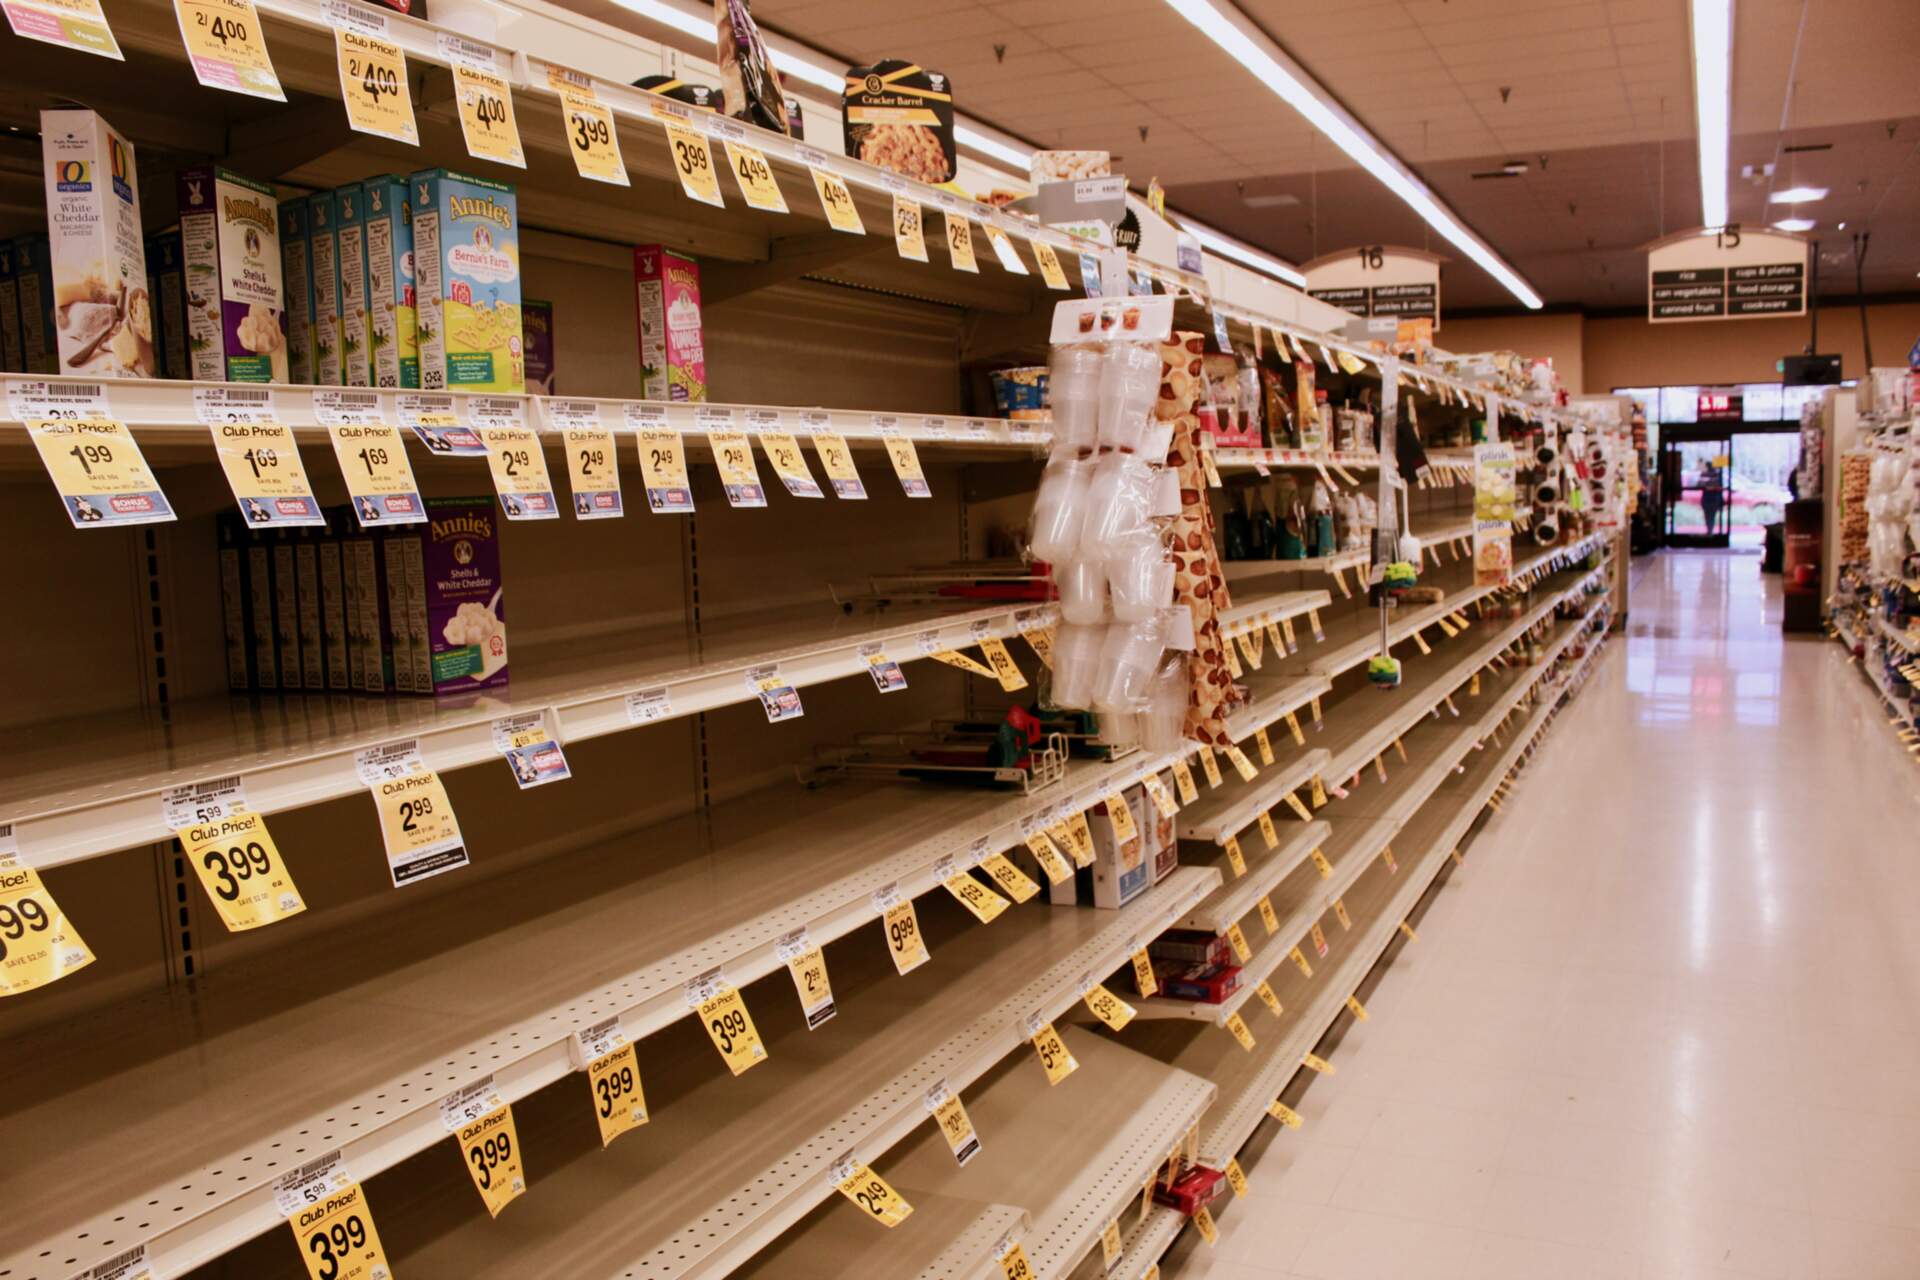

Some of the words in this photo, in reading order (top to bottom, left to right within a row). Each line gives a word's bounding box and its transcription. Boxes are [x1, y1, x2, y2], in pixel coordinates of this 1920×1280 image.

[344, 33, 368, 50] Club
[369, 41, 397, 58] Price!
[363, 62, 398, 104] 400
[862, 95, 895, 106] Cracker
[897, 96, 924, 107] Barrel
[477, 93, 506, 131] 400
[63, 160, 85, 184] O
[54, 212, 100, 223] Cheddar
[60, 203, 93, 214] White
[223, 195, 275, 235] Annie's
[449, 193, 512, 231] Annie's
[454, 248, 488, 265] Bernie's
[490, 255, 510, 269] Farm
[243, 268, 259, 280] Shells
[261, 274, 266, 283] &
[1679, 272, 1696, 281] rice
[1736, 269, 1757, 279] cups
[1759, 267, 1766, 276] &
[1767, 265, 1796, 277] plates
[231, 278, 252, 292] White
[252, 282, 277, 297] Cheddar
[1656, 290, 1672, 298] can
[1673, 286, 1721, 299] vegetables
[1736, 284, 1758, 294] food
[1760, 283, 1795, 295] storage
[1661, 304, 1693, 314] canned
[1695, 302, 1715, 312] fruit
[1742, 300, 1788, 311] cookware
[41, 422, 74, 434] Club
[77, 423, 118, 434] Price!
[222, 425, 250, 438] Club
[251, 425, 285, 438] Price!
[339, 426, 363, 438] Club
[364, 427, 392, 438] Price!
[488, 430, 507, 441] Club
[509, 431, 532, 441] Price!
[569, 430, 587, 441] Club
[588, 431, 608, 441] Price!
[641, 430, 659, 440] Club
[659, 431, 678, 441] Price!
[358, 447, 389, 476] 169
[432, 511, 493, 541] Annie's
[437, 578, 461, 591] White
[461, 576, 492, 589] Cheddar
[450, 567, 473, 579] Shells
[473, 567, 479, 578] &
[382, 782, 405, 796] Club
[406, 773, 434, 790] Price!
[399, 797, 433, 832] 299
[190, 827, 219, 842] Club
[221, 816, 257, 835] Price!
[203, 842, 271, 901] 399
[271, 879, 283, 889] ea
[5, 955, 27, 969] SAVE
[26, 949, 48, 962] $2.00
[701, 1002, 717, 1015] Club
[717, 991, 736, 1006] Price!
[711, 1009, 746, 1055] 399
[592, 1058, 610, 1073] Club
[610, 1046, 631, 1064] Price!
[597, 1066, 634, 1118] 399
[462, 1124, 482, 1141] Club
[483, 1108, 507, 1130] Price!
[470, 1131, 511, 1190] 399
[303, 1182, 327, 1203] 599
[856, 1181, 888, 1216] 249
[299, 1206, 324, 1227] Club
[326, 1188, 357, 1214] Price!
[309, 1215, 366, 1280] 399
[365, 1251, 376, 1260] ea
